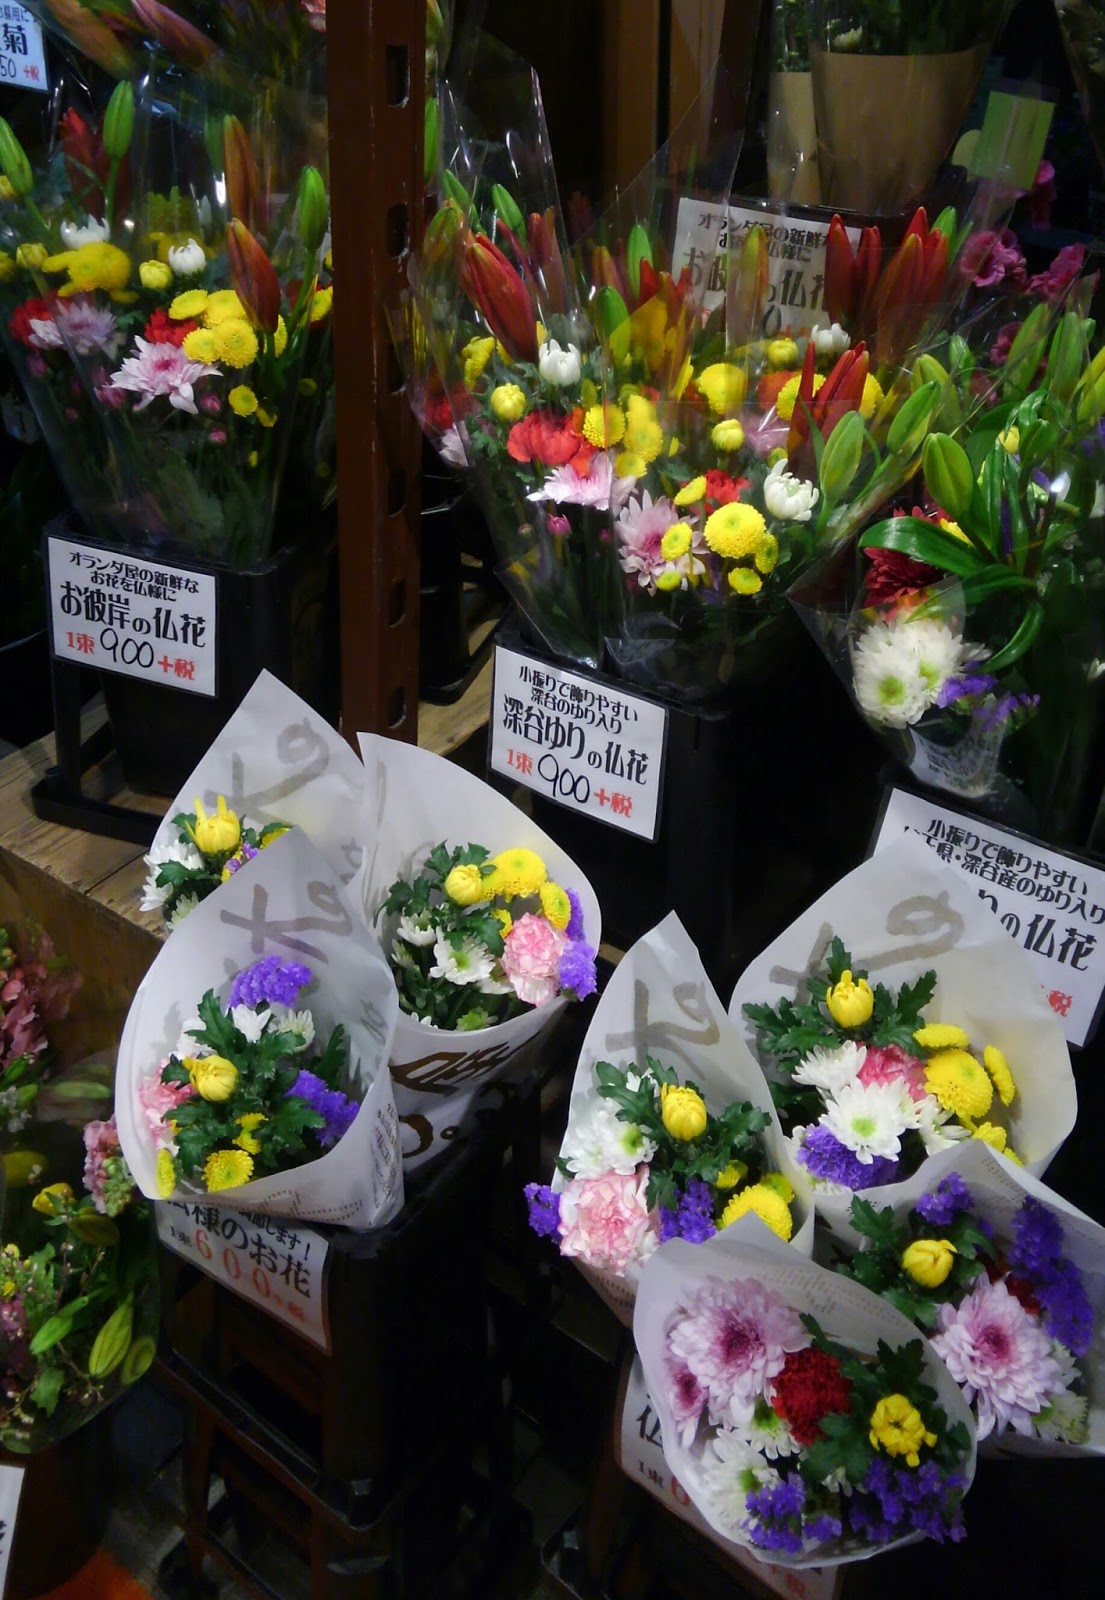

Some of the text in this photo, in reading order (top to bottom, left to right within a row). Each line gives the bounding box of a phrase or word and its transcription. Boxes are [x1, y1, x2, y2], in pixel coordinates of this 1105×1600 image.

[69, 551, 200, 594] オランダ屋の新鮮な
[90, 570, 177, 602] お花を仏様に
[60, 580, 206, 648] お彼岸の仏花
[100, 627, 155, 669] 900
[519, 665, 639, 722] 小振りで飾りやすい
[530, 687, 622, 735] 深谷のゆり入り
[503, 694, 649, 786] 深谷ゆりの仏花
[537, 753, 590, 804] 900
[926, 818, 1088, 896] 小振りで飾りやすい
[194, 1228, 272, 1298] 600
